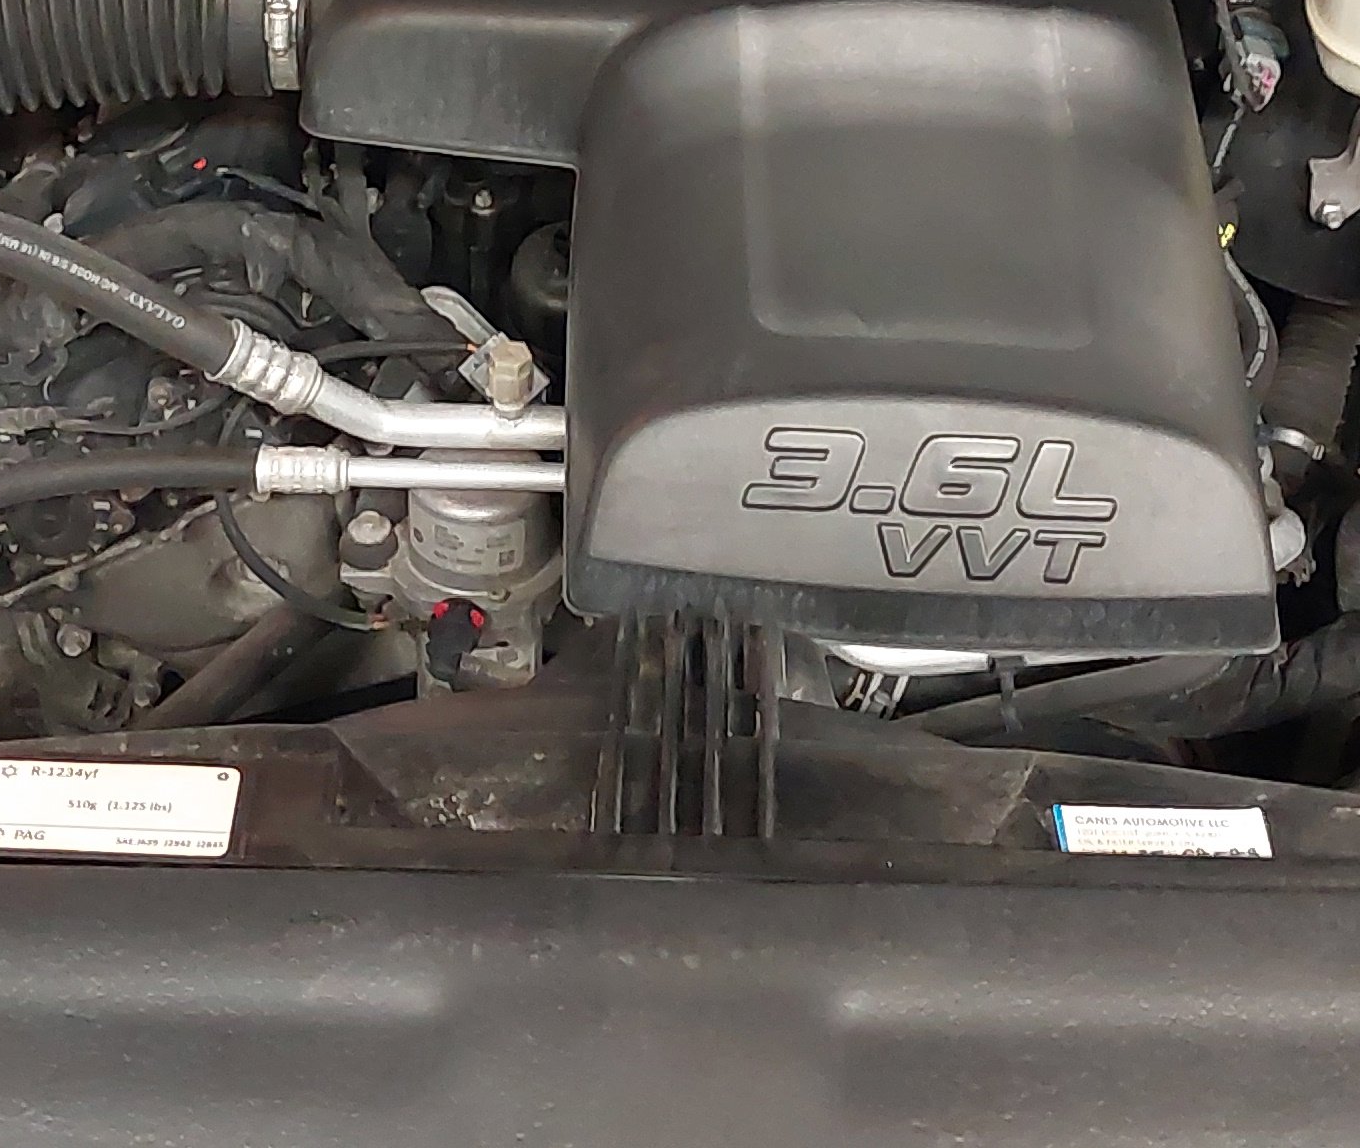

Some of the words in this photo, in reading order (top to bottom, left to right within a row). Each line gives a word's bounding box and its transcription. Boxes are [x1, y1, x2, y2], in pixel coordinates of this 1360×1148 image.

[741, 426, 1118, 522] 3.6L
[876, 522, 1107, 585] VVT
[31, 766, 100, 780] R-1234yf
[67, 798, 97, 811] 510g
[1075, 815, 1118, 825] CANES
[1122, 817, 1204, 827] AUTOMOTIVE
[14, 829, 46, 842] PAG
